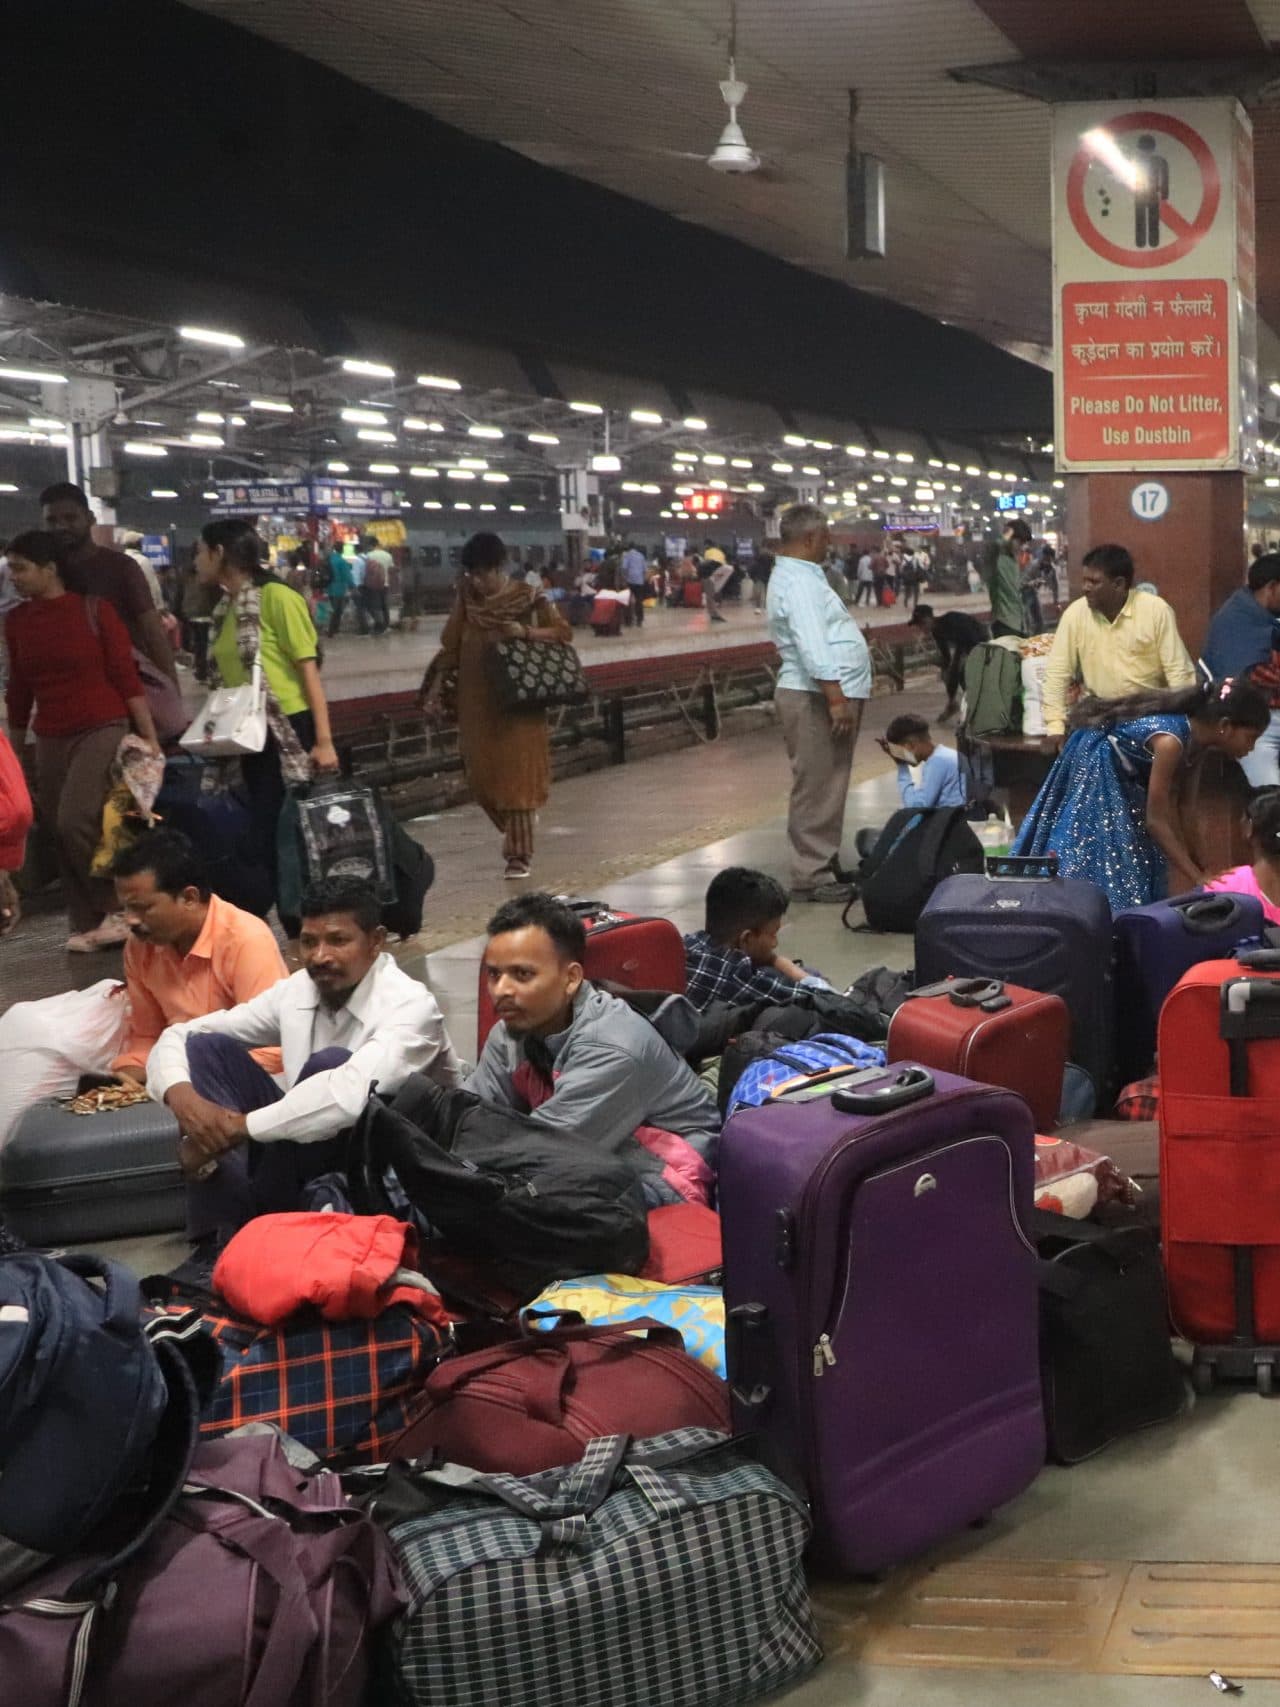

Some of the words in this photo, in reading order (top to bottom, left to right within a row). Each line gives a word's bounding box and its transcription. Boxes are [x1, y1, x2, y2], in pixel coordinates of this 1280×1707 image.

[1114, 294, 1147, 318] गंदगी
[1152, 300, 1164, 318] न
[1071, 336, 1120, 366] कूड़ेदान
[1125, 341, 1145, 359] का
[1149, 335, 1184, 359] प्रयोग
[1071, 396, 1120, 415] Please
[1125, 395, 1144, 414] Do
[1149, 394, 1174, 413] Not
[1179, 394, 1223, 415] Litter,
[1103, 427, 1130, 445] Use
[1135, 425, 1191, 444] Dustbin
[1139, 490, 1160, 513] 17
